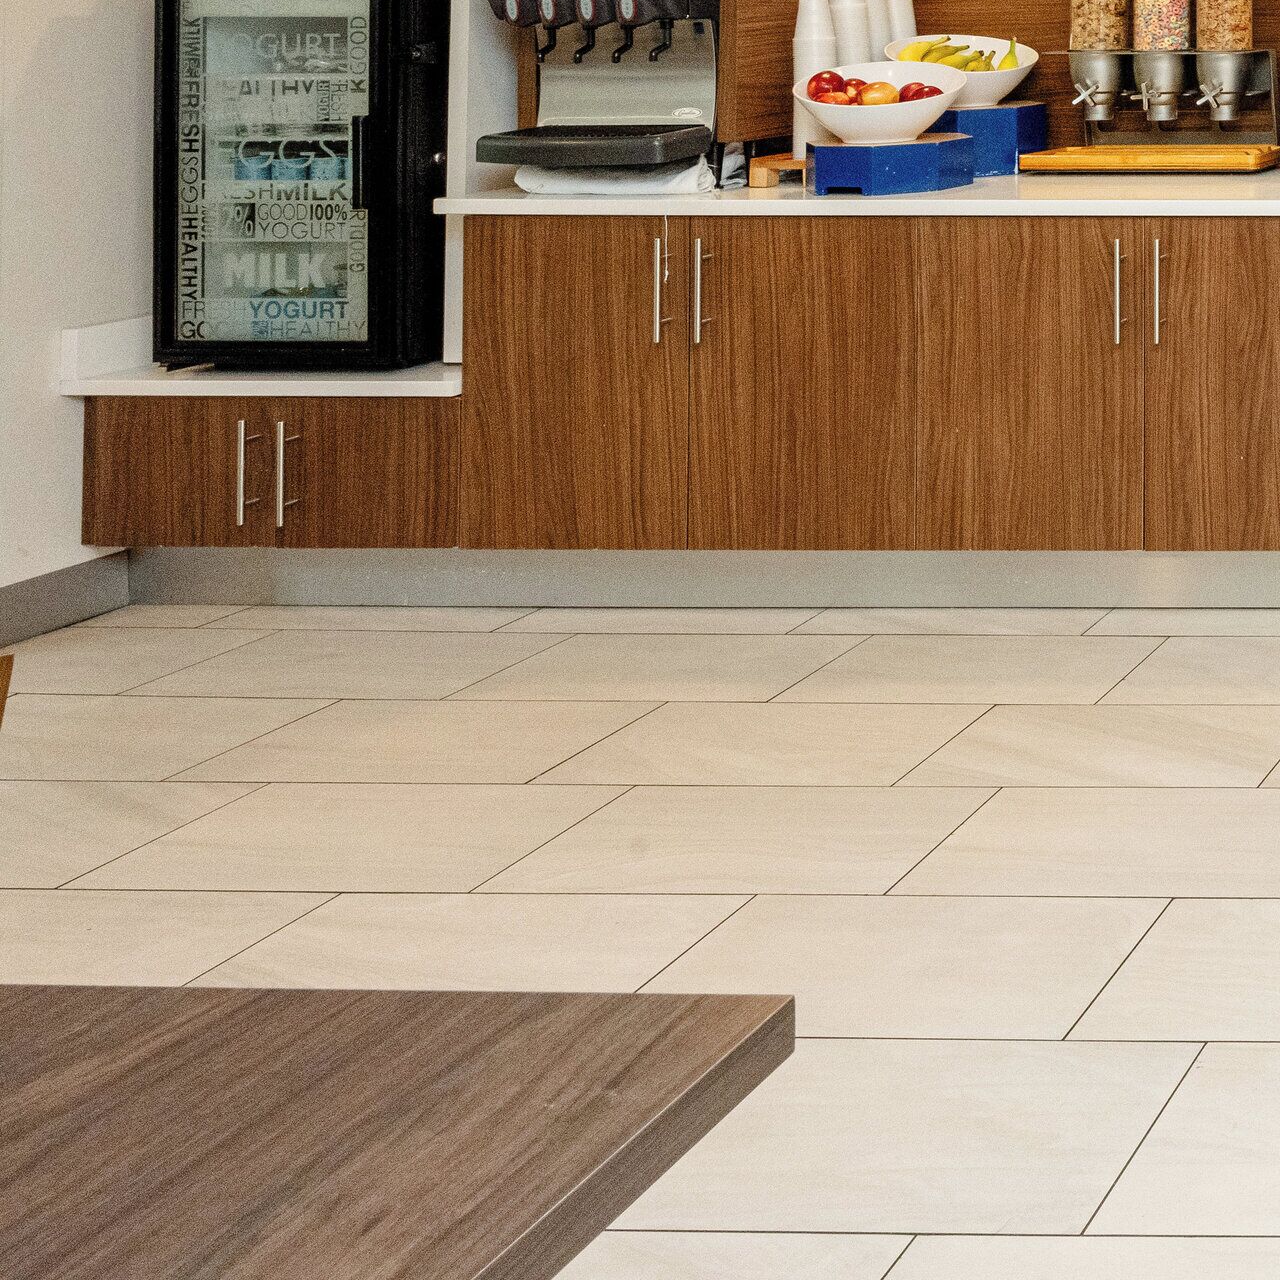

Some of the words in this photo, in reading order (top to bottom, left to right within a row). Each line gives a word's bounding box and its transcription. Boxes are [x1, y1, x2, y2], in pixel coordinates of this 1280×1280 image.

[350, 16, 367, 74] GOOD
[181, 82, 199, 153] FRESH
[181, 154, 198, 215] EGGS
[257, 202, 309, 221] GOOD
[310, 203, 348, 221] 100%
[257, 222, 347, 240] YOGURT
[181, 216, 198, 300] HEALTHY
[223, 253, 327, 288] MILK
[249, 300, 349, 319] YOGURT
[269, 321, 367, 340] HEALTHY
